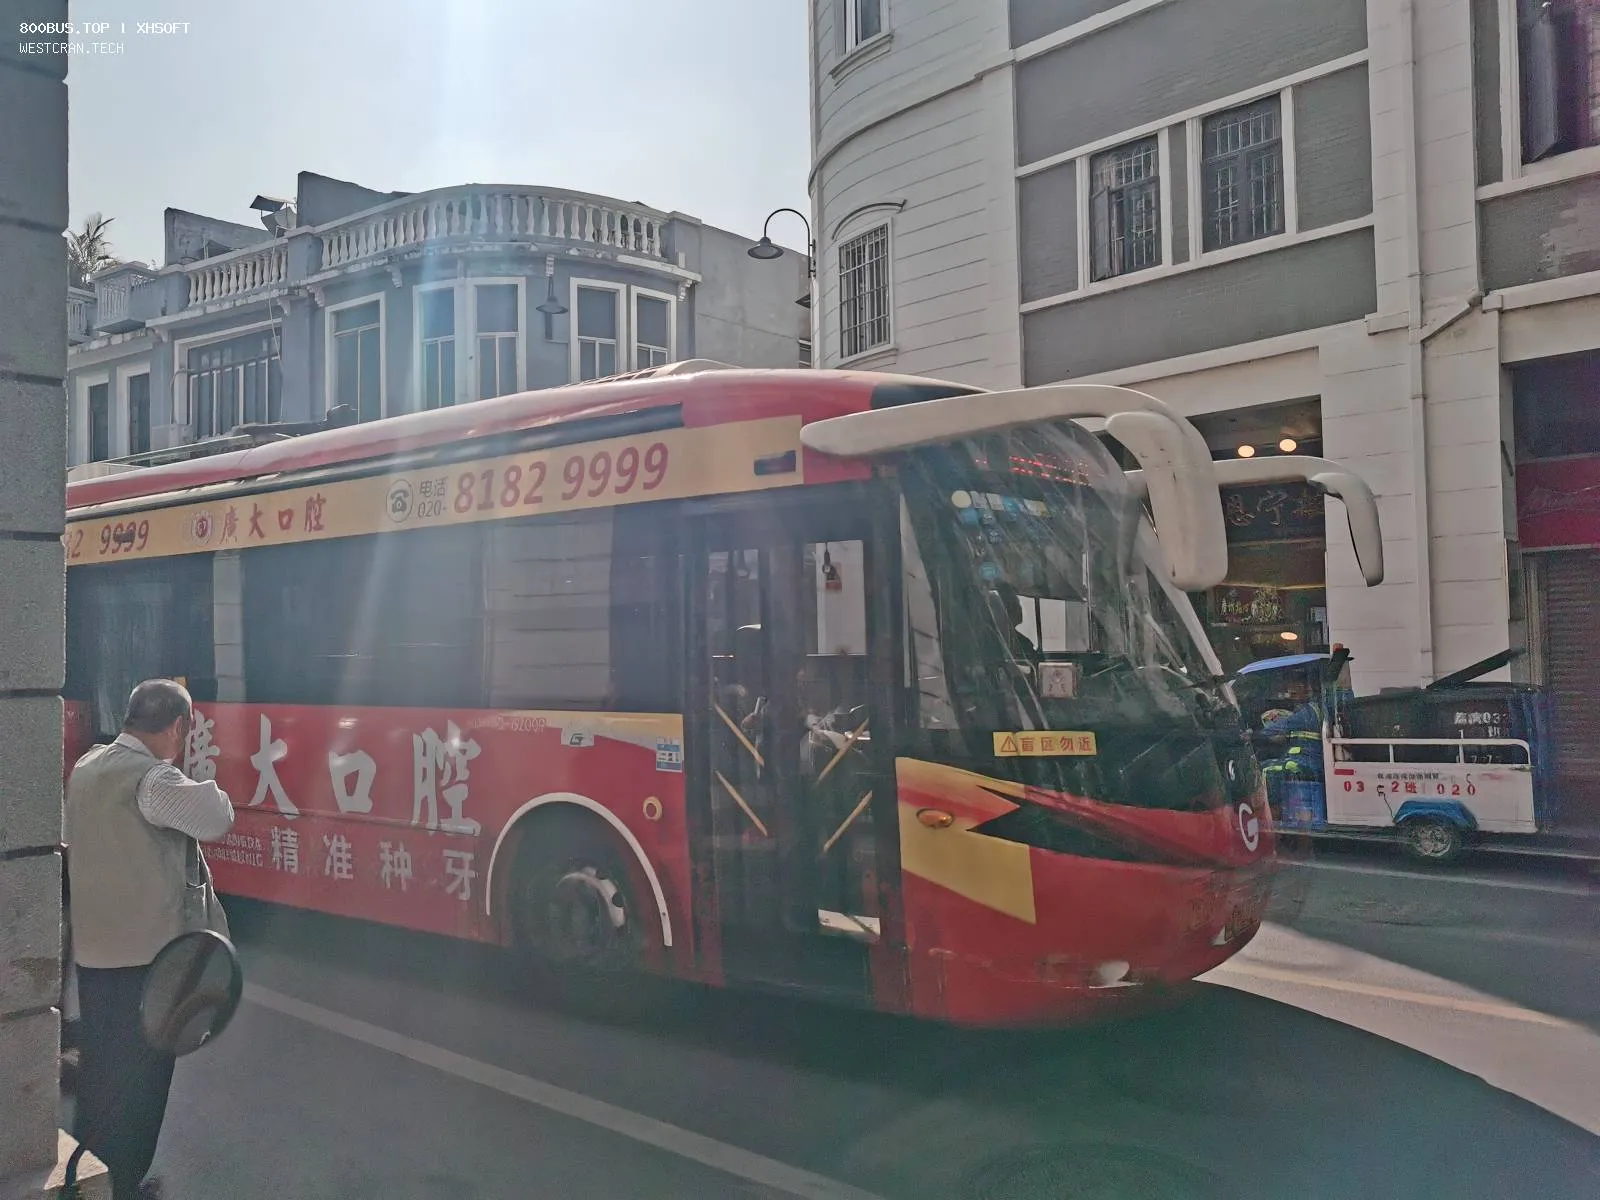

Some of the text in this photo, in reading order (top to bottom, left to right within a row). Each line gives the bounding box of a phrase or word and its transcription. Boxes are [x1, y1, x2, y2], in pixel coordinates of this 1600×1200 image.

[419, 476, 448, 498] 电话
[453, 441, 670, 514] 8182 9999
[220, 492, 327, 544] 廣大口腔
[1020, 736, 1092, 752] 盲区勿近
[271, 825, 479, 901] 精准种牙
